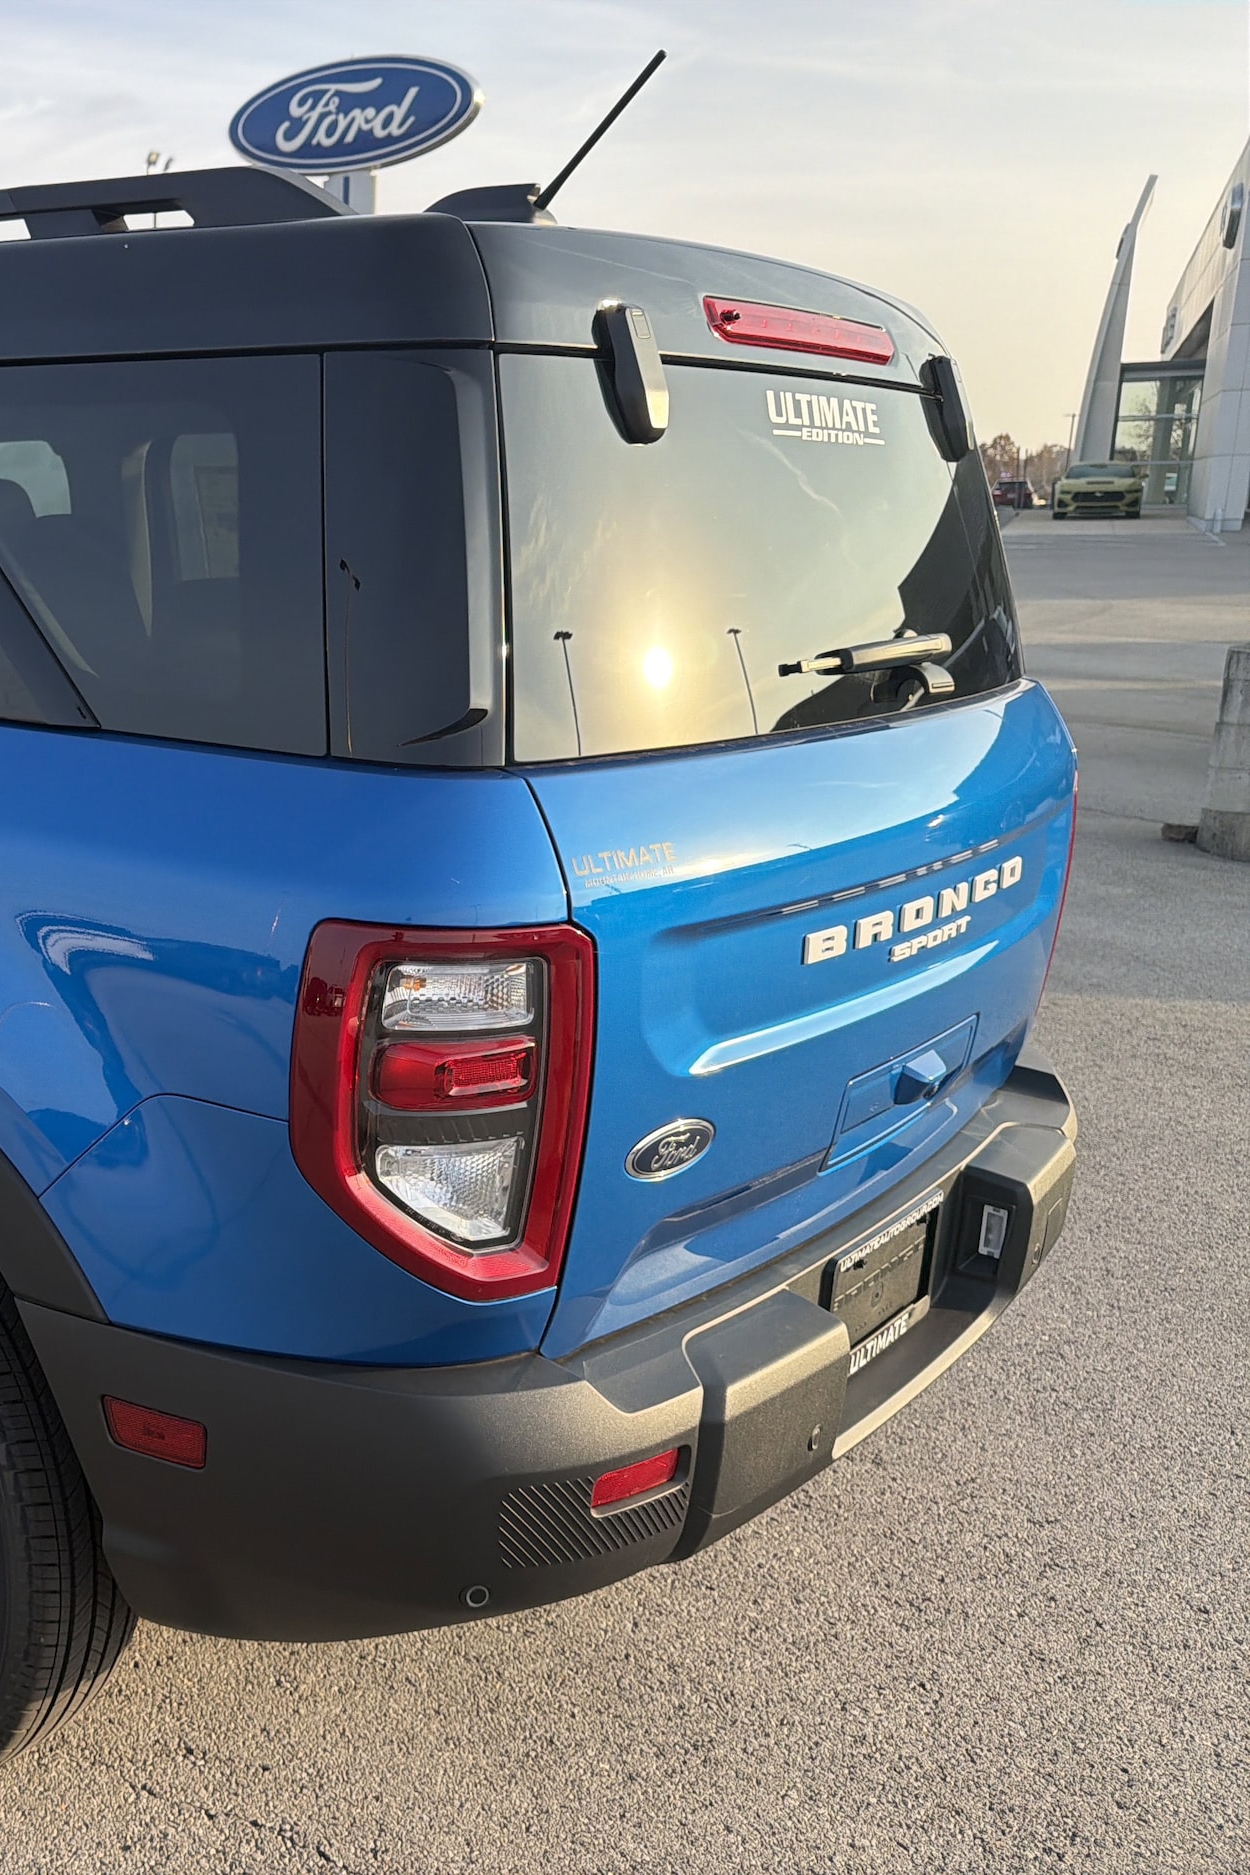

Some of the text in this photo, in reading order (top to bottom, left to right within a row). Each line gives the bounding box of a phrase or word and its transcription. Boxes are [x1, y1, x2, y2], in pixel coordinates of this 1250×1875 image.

[275, 77, 420, 153] Ford
[766, 389, 881, 434] ULTIMATE
[801, 427, 864, 446] EDITION
[571, 841, 678, 877] ULTIMATE
[802, 855, 1023, 965] BRONCO
[889, 915, 972, 963] SPORT
[651, 1132, 701, 1171] Ford
[849, 1313, 910, 1376] ULTIMATE
